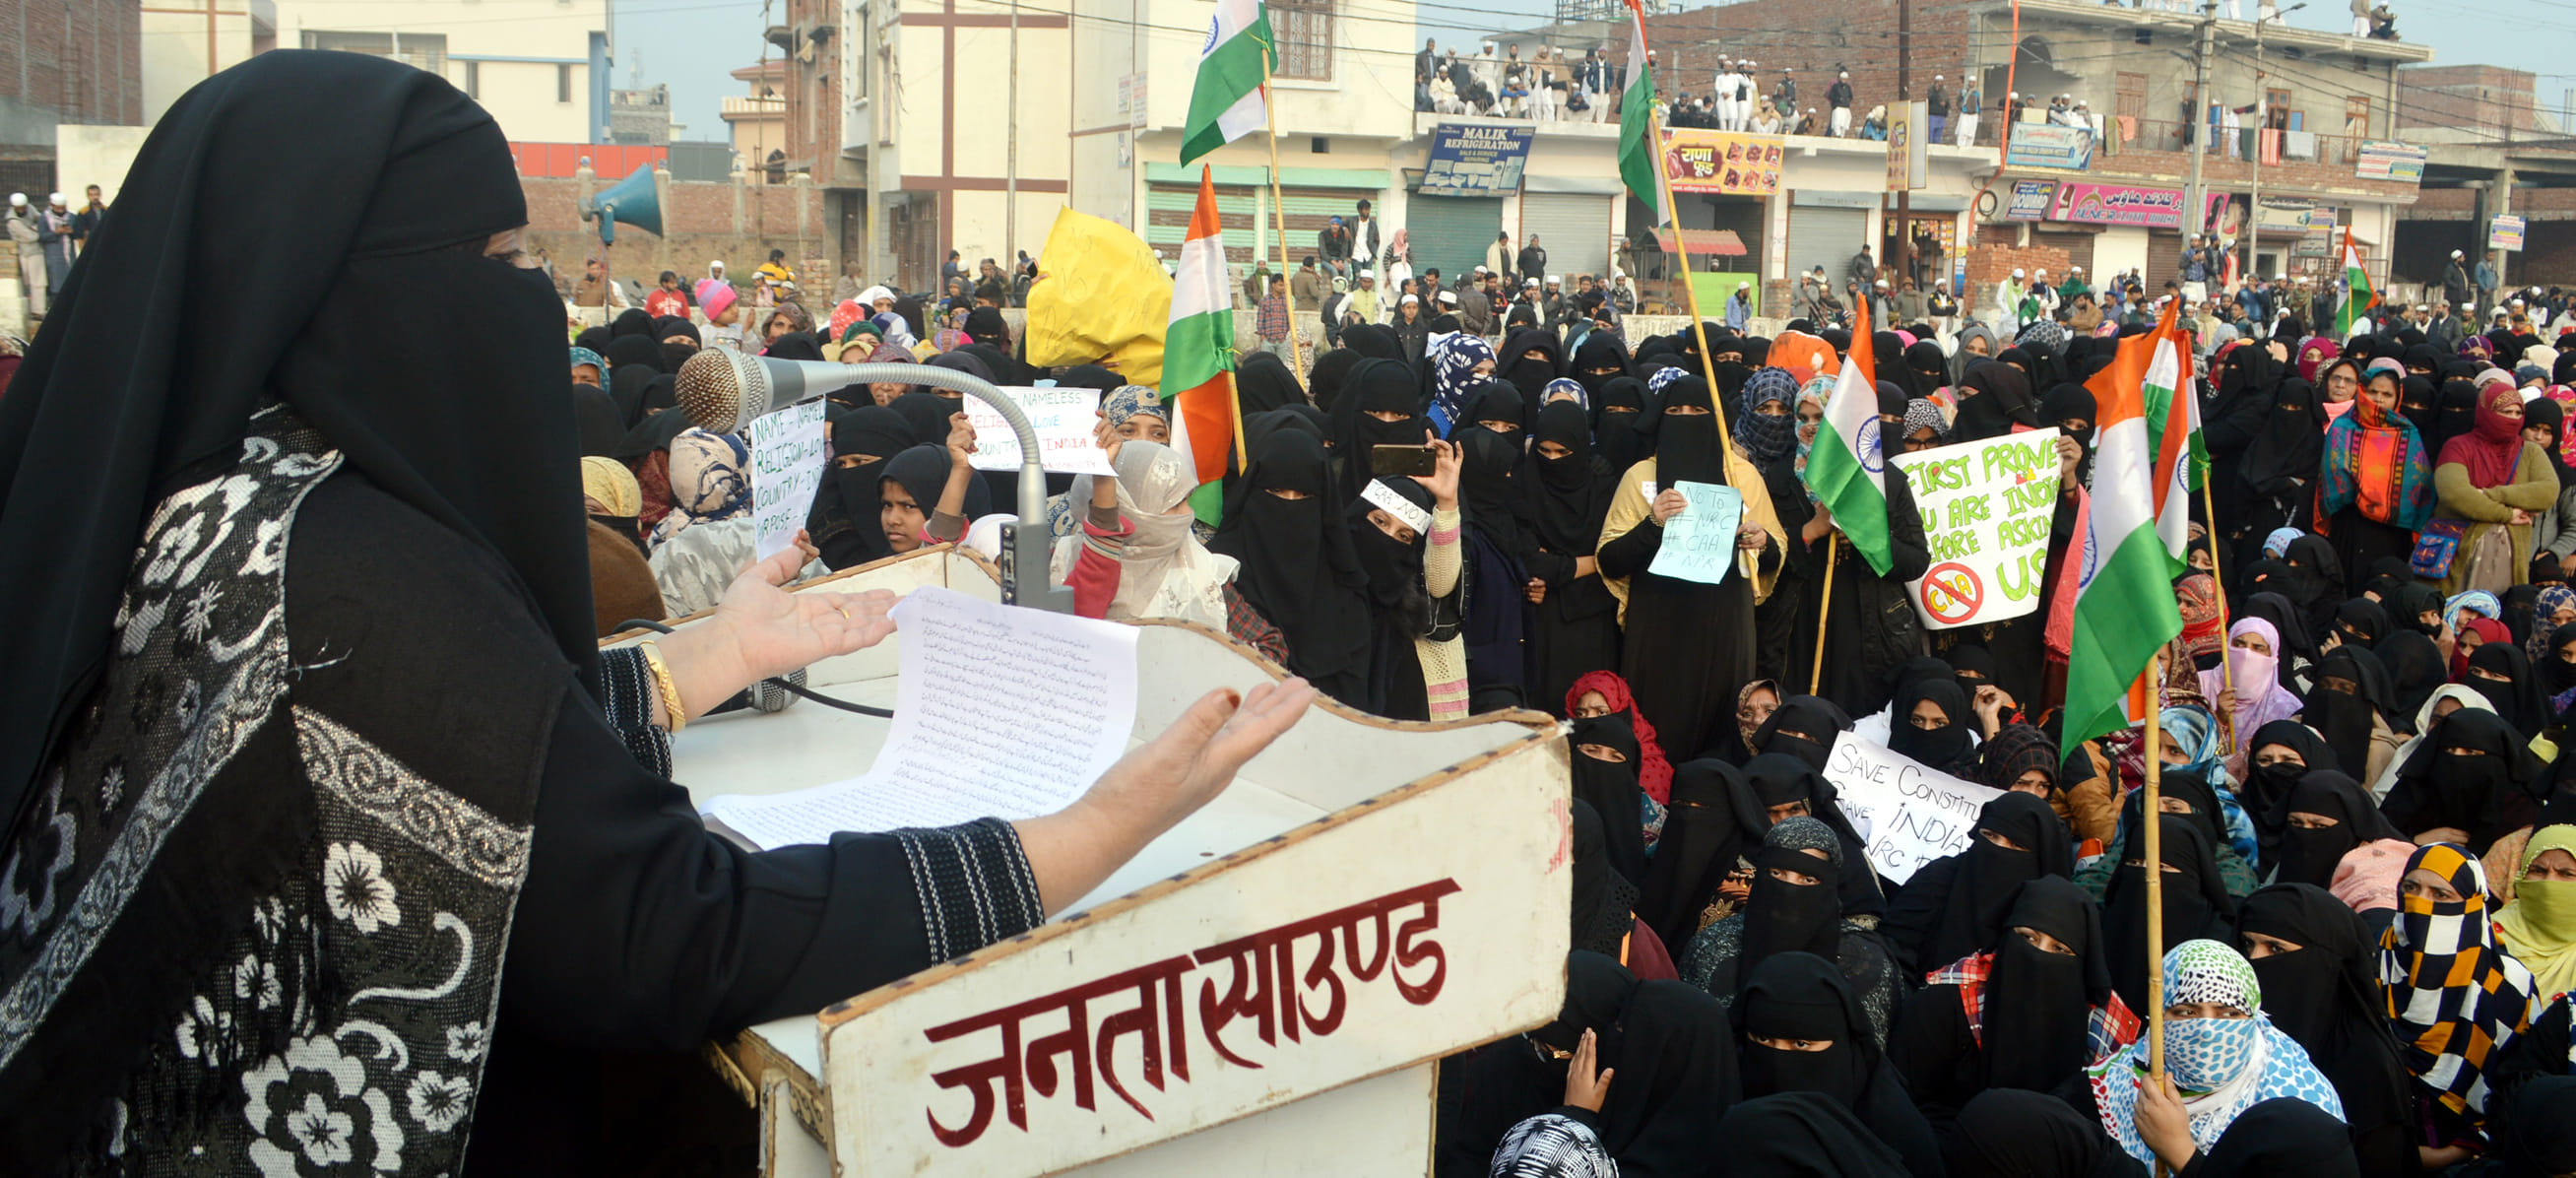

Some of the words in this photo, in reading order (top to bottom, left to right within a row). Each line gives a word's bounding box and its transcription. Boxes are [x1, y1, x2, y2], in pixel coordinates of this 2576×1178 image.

[1462, 127, 1509, 140] MALIK
[1444, 138, 1520, 151] REFRIGERATION
[1681, 147, 1713, 163] राणा
[1694, 161, 1715, 177] फूड
[1023, 392, 1082, 407] NAMELESS
[755, 412, 786, 445] NAME
[1034, 415, 1061, 428] LOVE
[1043, 437, 1087, 451] INDIA
[1981, 436, 2059, 483] PROVE
[1948, 493, 1991, 529] ARE
[1686, 534, 1720, 552] CAA
[1996, 548, 2047, 602] US
[1831, 744, 1890, 784] SAVE
[924, 953, 1196, 1147] जनता
